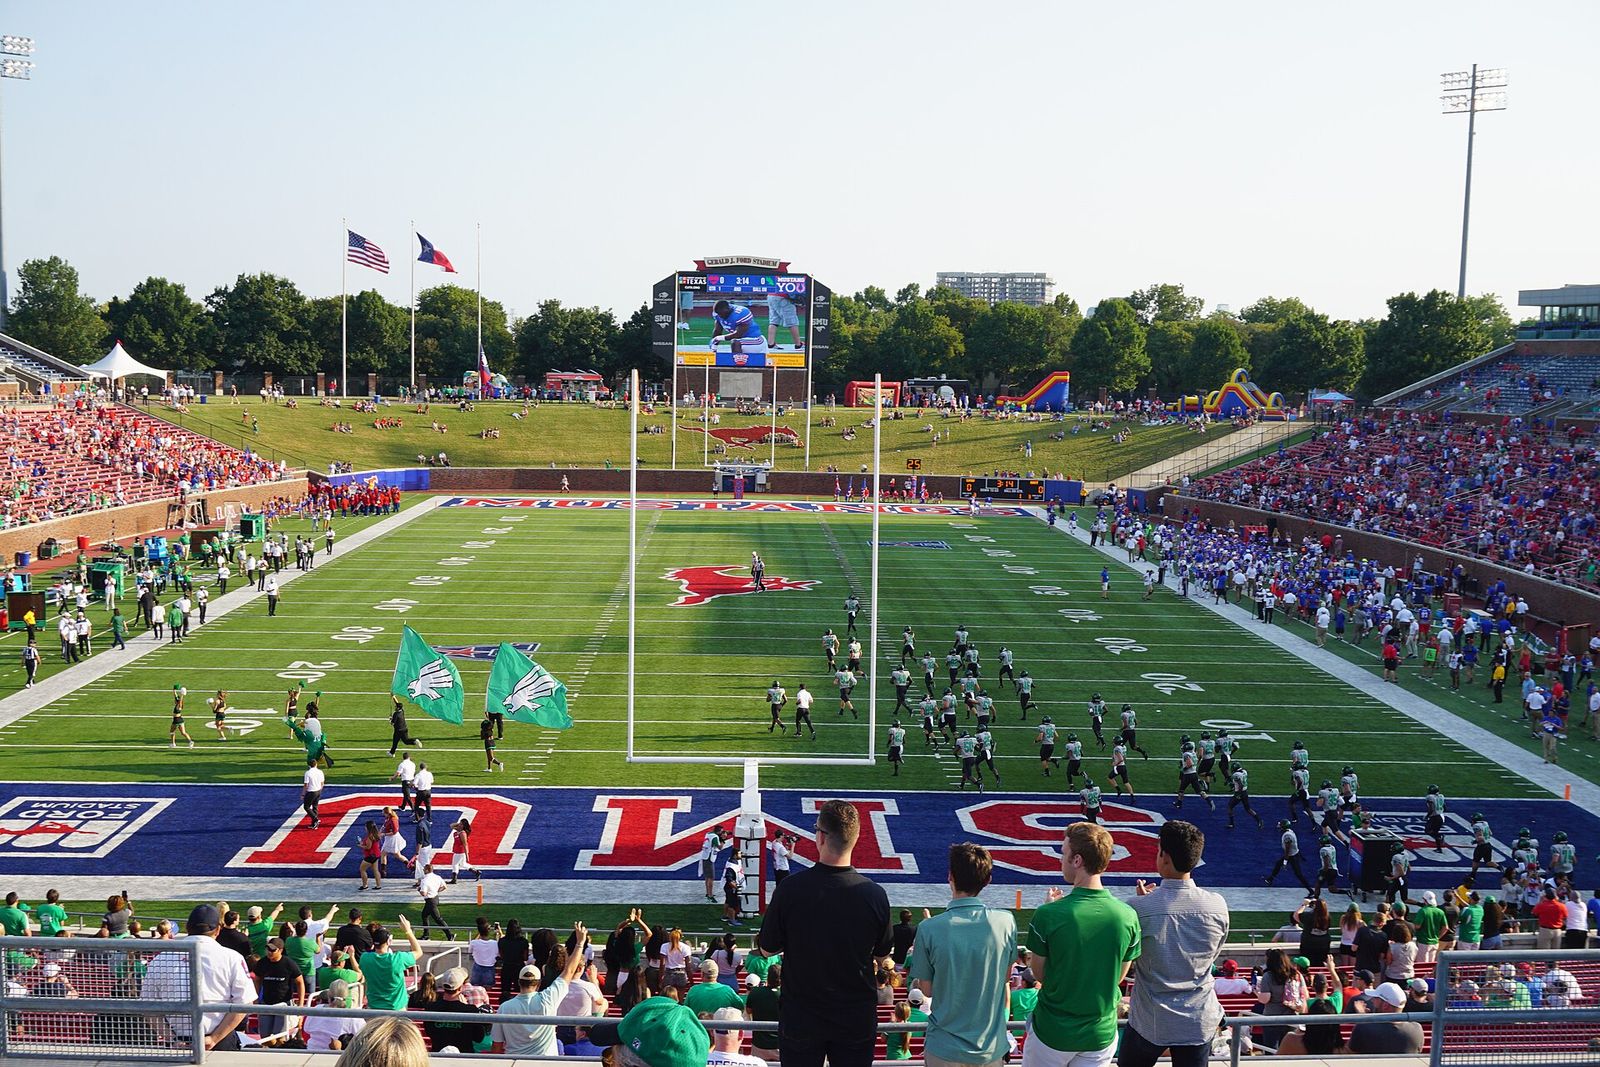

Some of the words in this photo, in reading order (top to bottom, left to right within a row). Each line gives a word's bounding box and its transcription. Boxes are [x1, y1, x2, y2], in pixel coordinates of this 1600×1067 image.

[753, 258, 778, 267] STADIUM
[777, 282, 806, 293] YOU
[654, 314, 672, 322] SMU
[908, 459, 920, 469] 25
[996, 480, 1014, 488] 3:14
[449, 497, 1020, 516] MUSTANGS
[330, 626, 385, 641] 30
[1094, 637, 1149, 652] 30
[276, 660, 339, 679] 20
[1140, 672, 1206, 692] 20
[205, 706, 279, 730] 10
[1200, 719, 1278, 743] 10
[19, 810, 132, 819] FORD
[225, 792, 1206, 879] SMU
